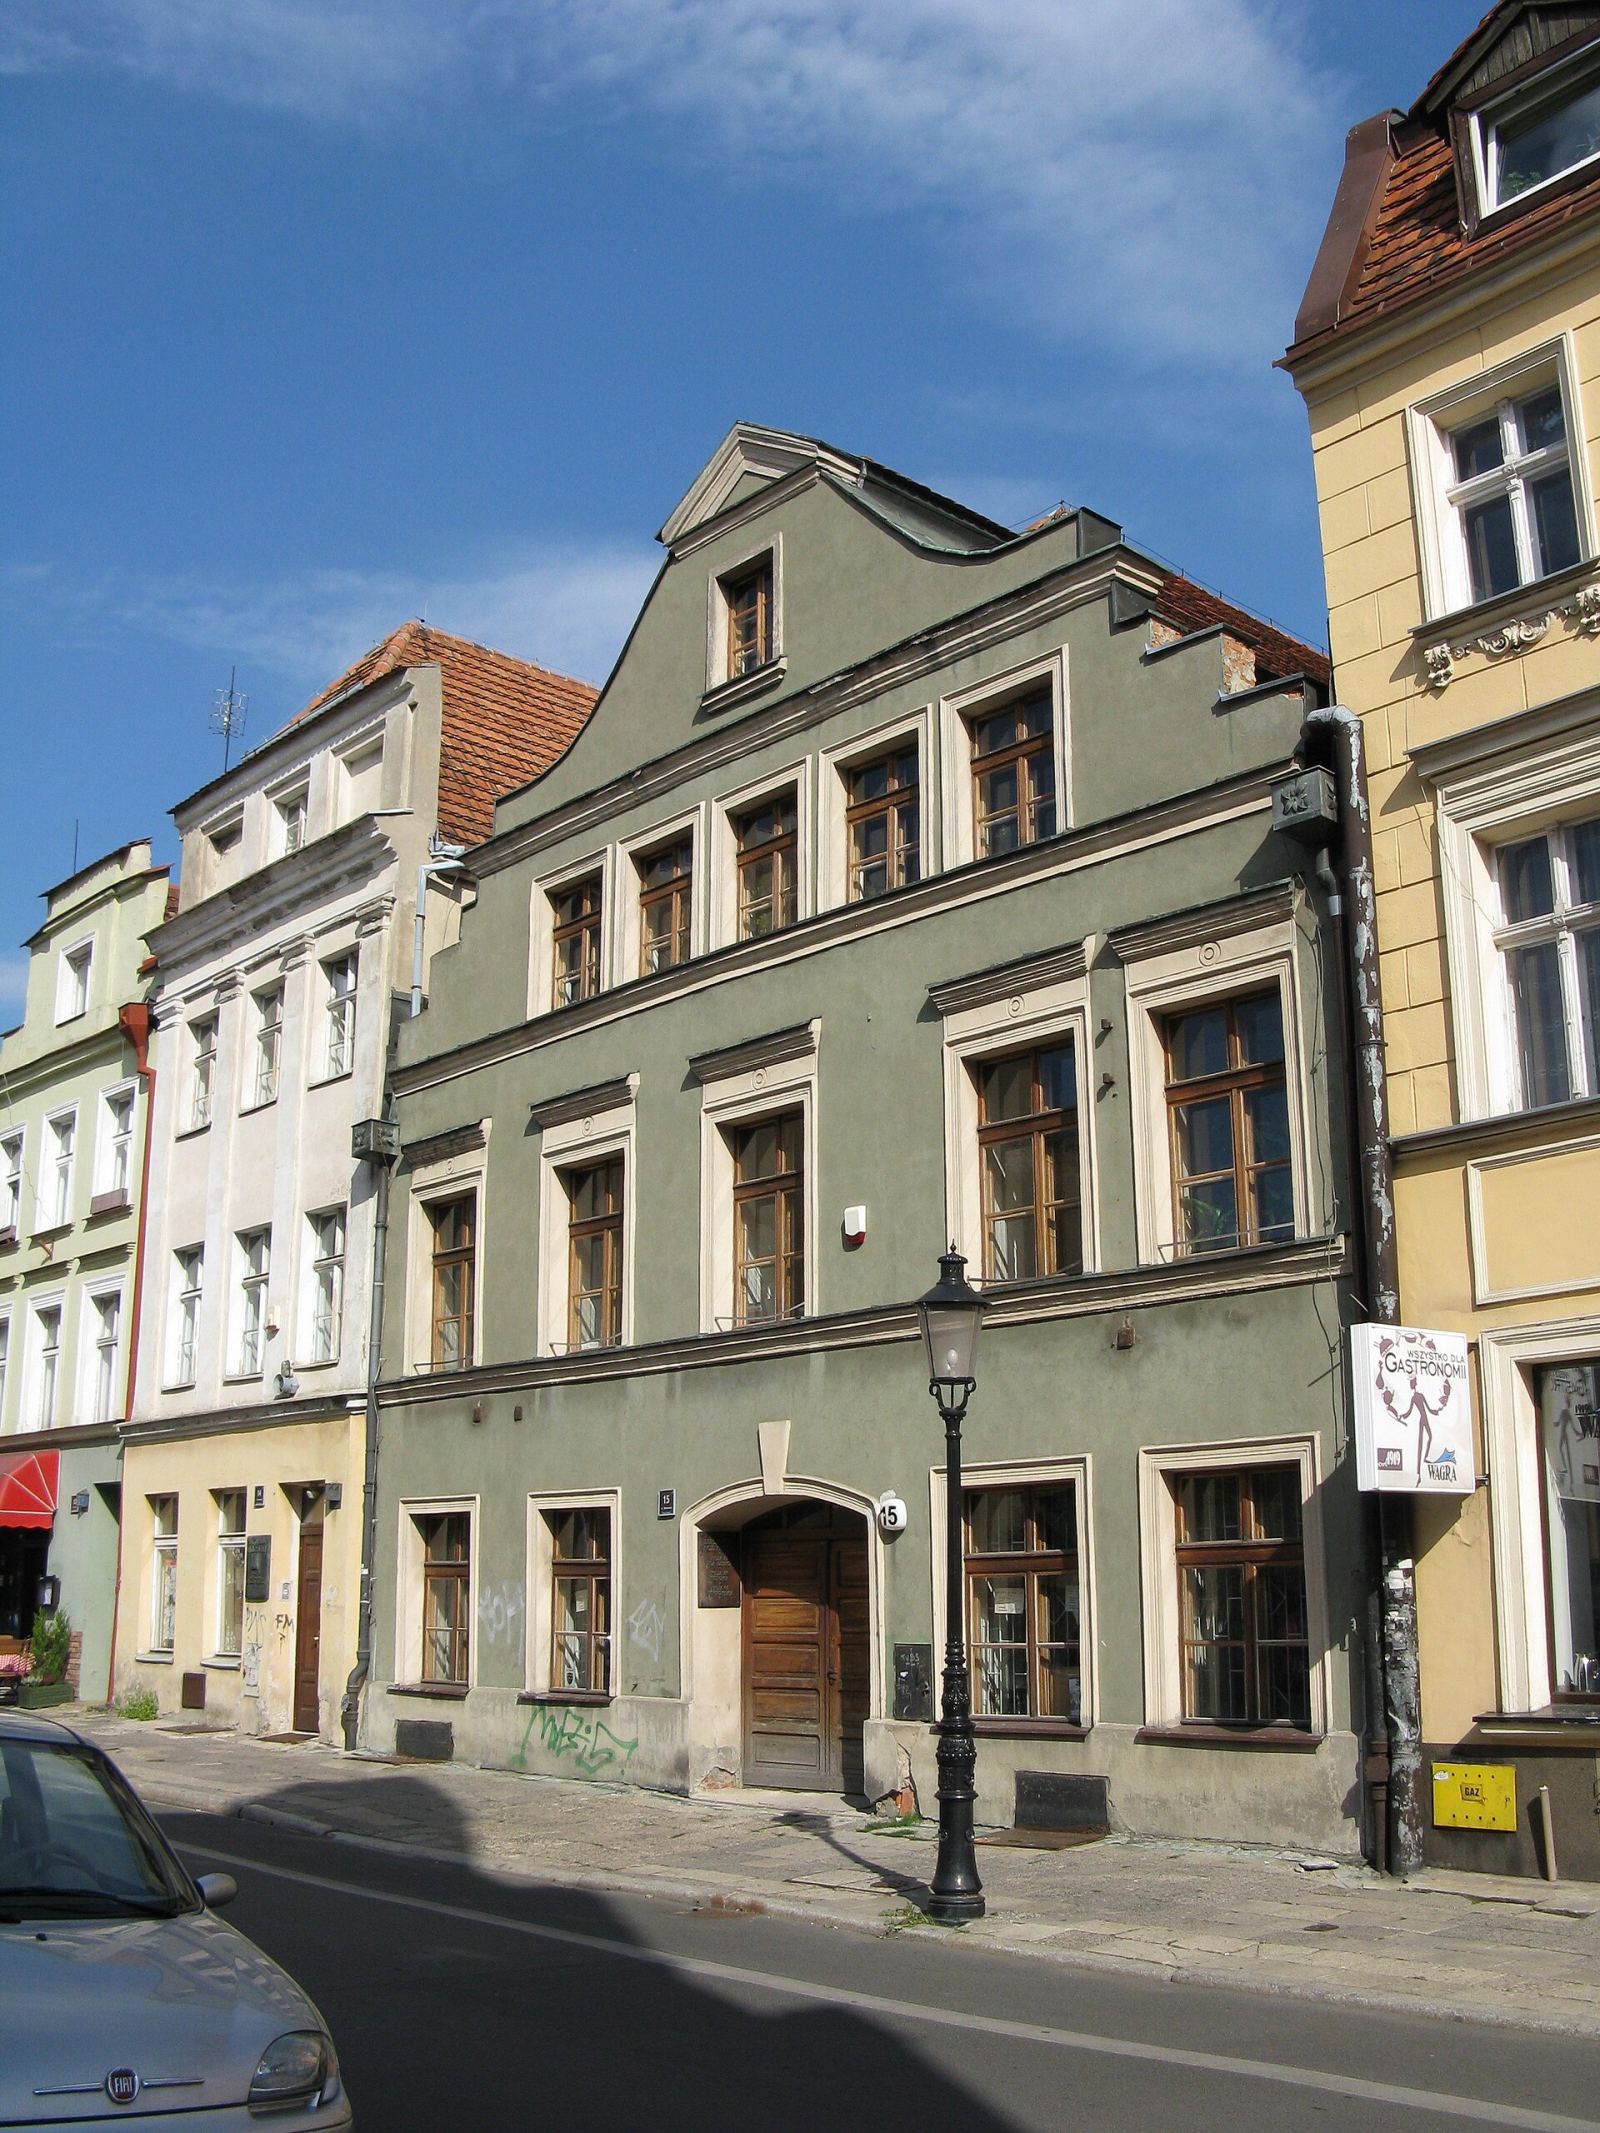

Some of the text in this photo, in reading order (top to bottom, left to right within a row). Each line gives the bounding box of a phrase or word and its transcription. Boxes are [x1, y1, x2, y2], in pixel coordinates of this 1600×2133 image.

[1407, 1349, 1466, 1364] WSZYSTKO DLA
[1384, 1352, 1467, 1379] GASTRONOMII
[1427, 1464, 1457, 1482] WAGRA
[663, 1495, 670, 1504] 15
[880, 1505, 898, 1526] 15
[1464, 1787, 1480, 1797] GAZ
[114, 2076, 133, 2093] FIAT
